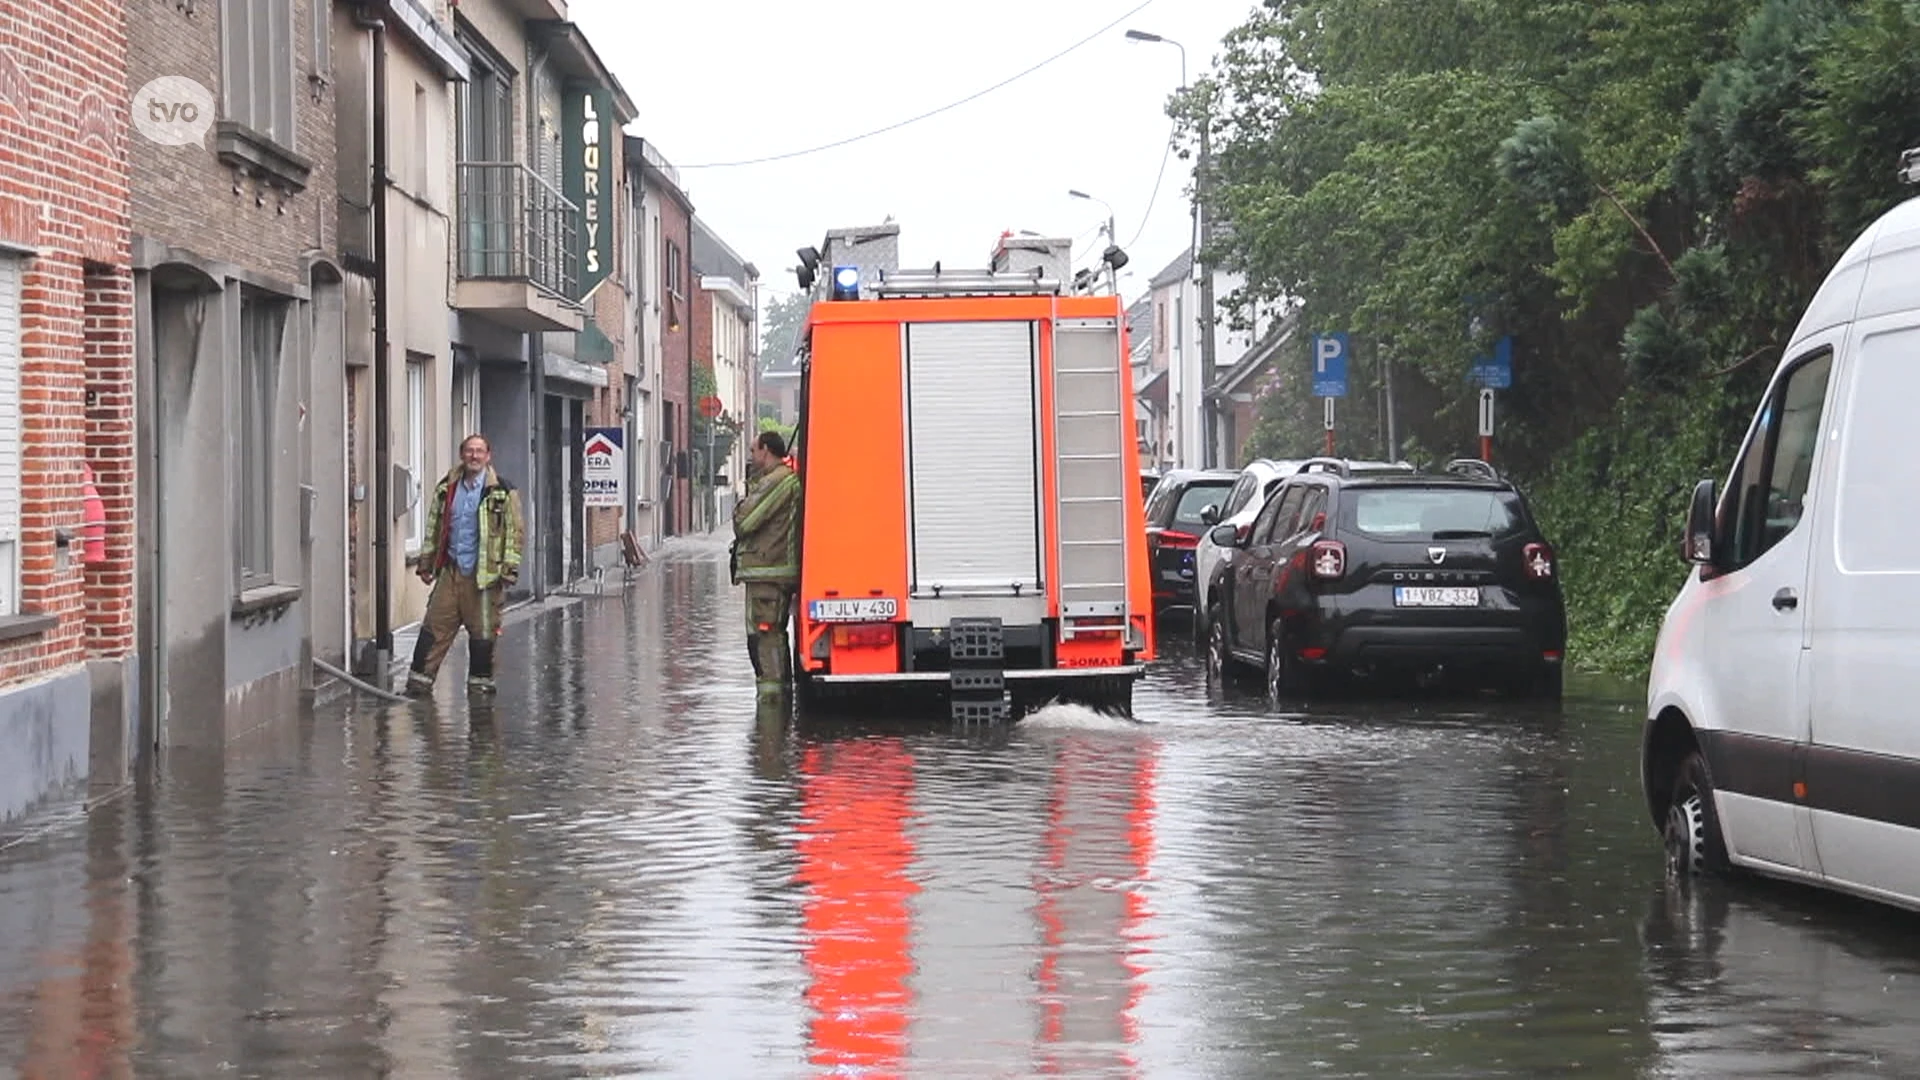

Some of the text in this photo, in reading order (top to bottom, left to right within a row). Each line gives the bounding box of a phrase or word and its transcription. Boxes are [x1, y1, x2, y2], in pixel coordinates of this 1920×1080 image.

[583, 94, 599, 272] LAUREYS
[1318, 339, 1342, 373] P
[587, 457, 611, 466] ERA
[583, 480, 618, 489] OPEN
